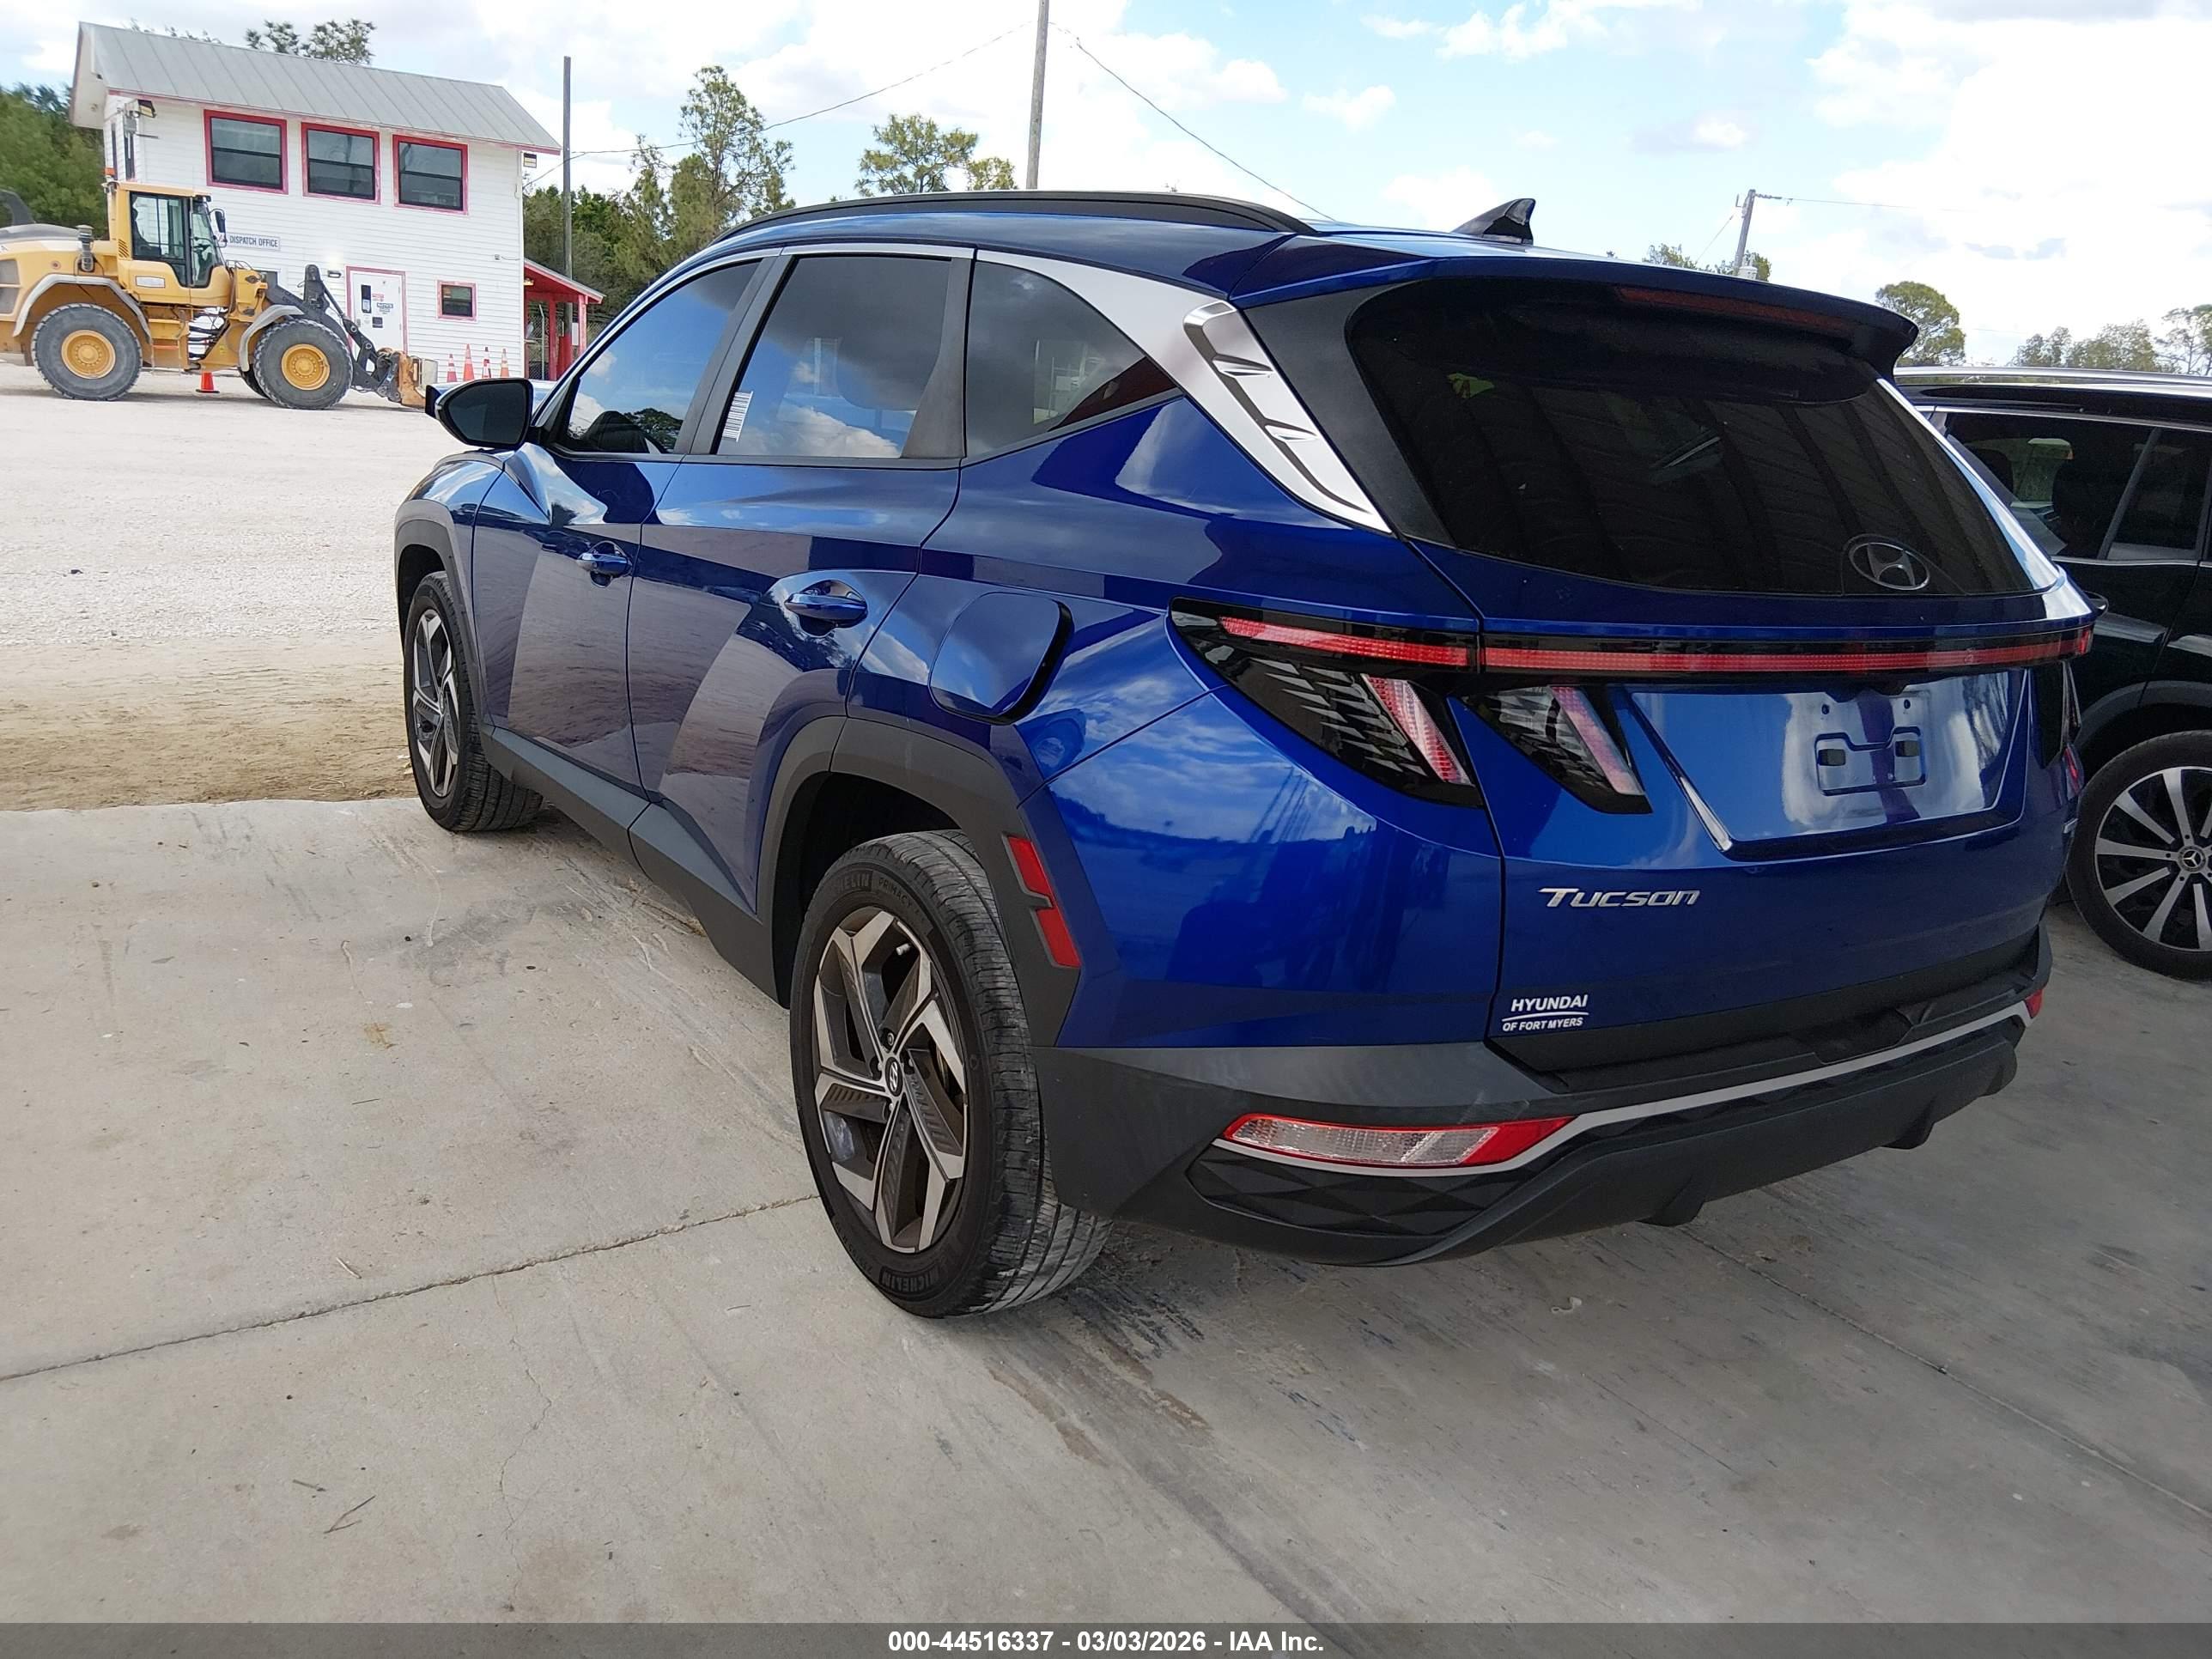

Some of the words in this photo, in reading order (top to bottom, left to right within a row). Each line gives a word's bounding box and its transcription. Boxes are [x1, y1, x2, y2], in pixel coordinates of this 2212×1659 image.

[229, 235, 257, 246] DISPATCH
[258, 238, 278, 248] OFFICE
[1511, 994, 1589, 1012] HYUNDAI
[1502, 1022, 1518, 1031] OF
[1519, 1020, 1547, 1030] FORT
[1547, 1018, 1583, 1029] MYERS
